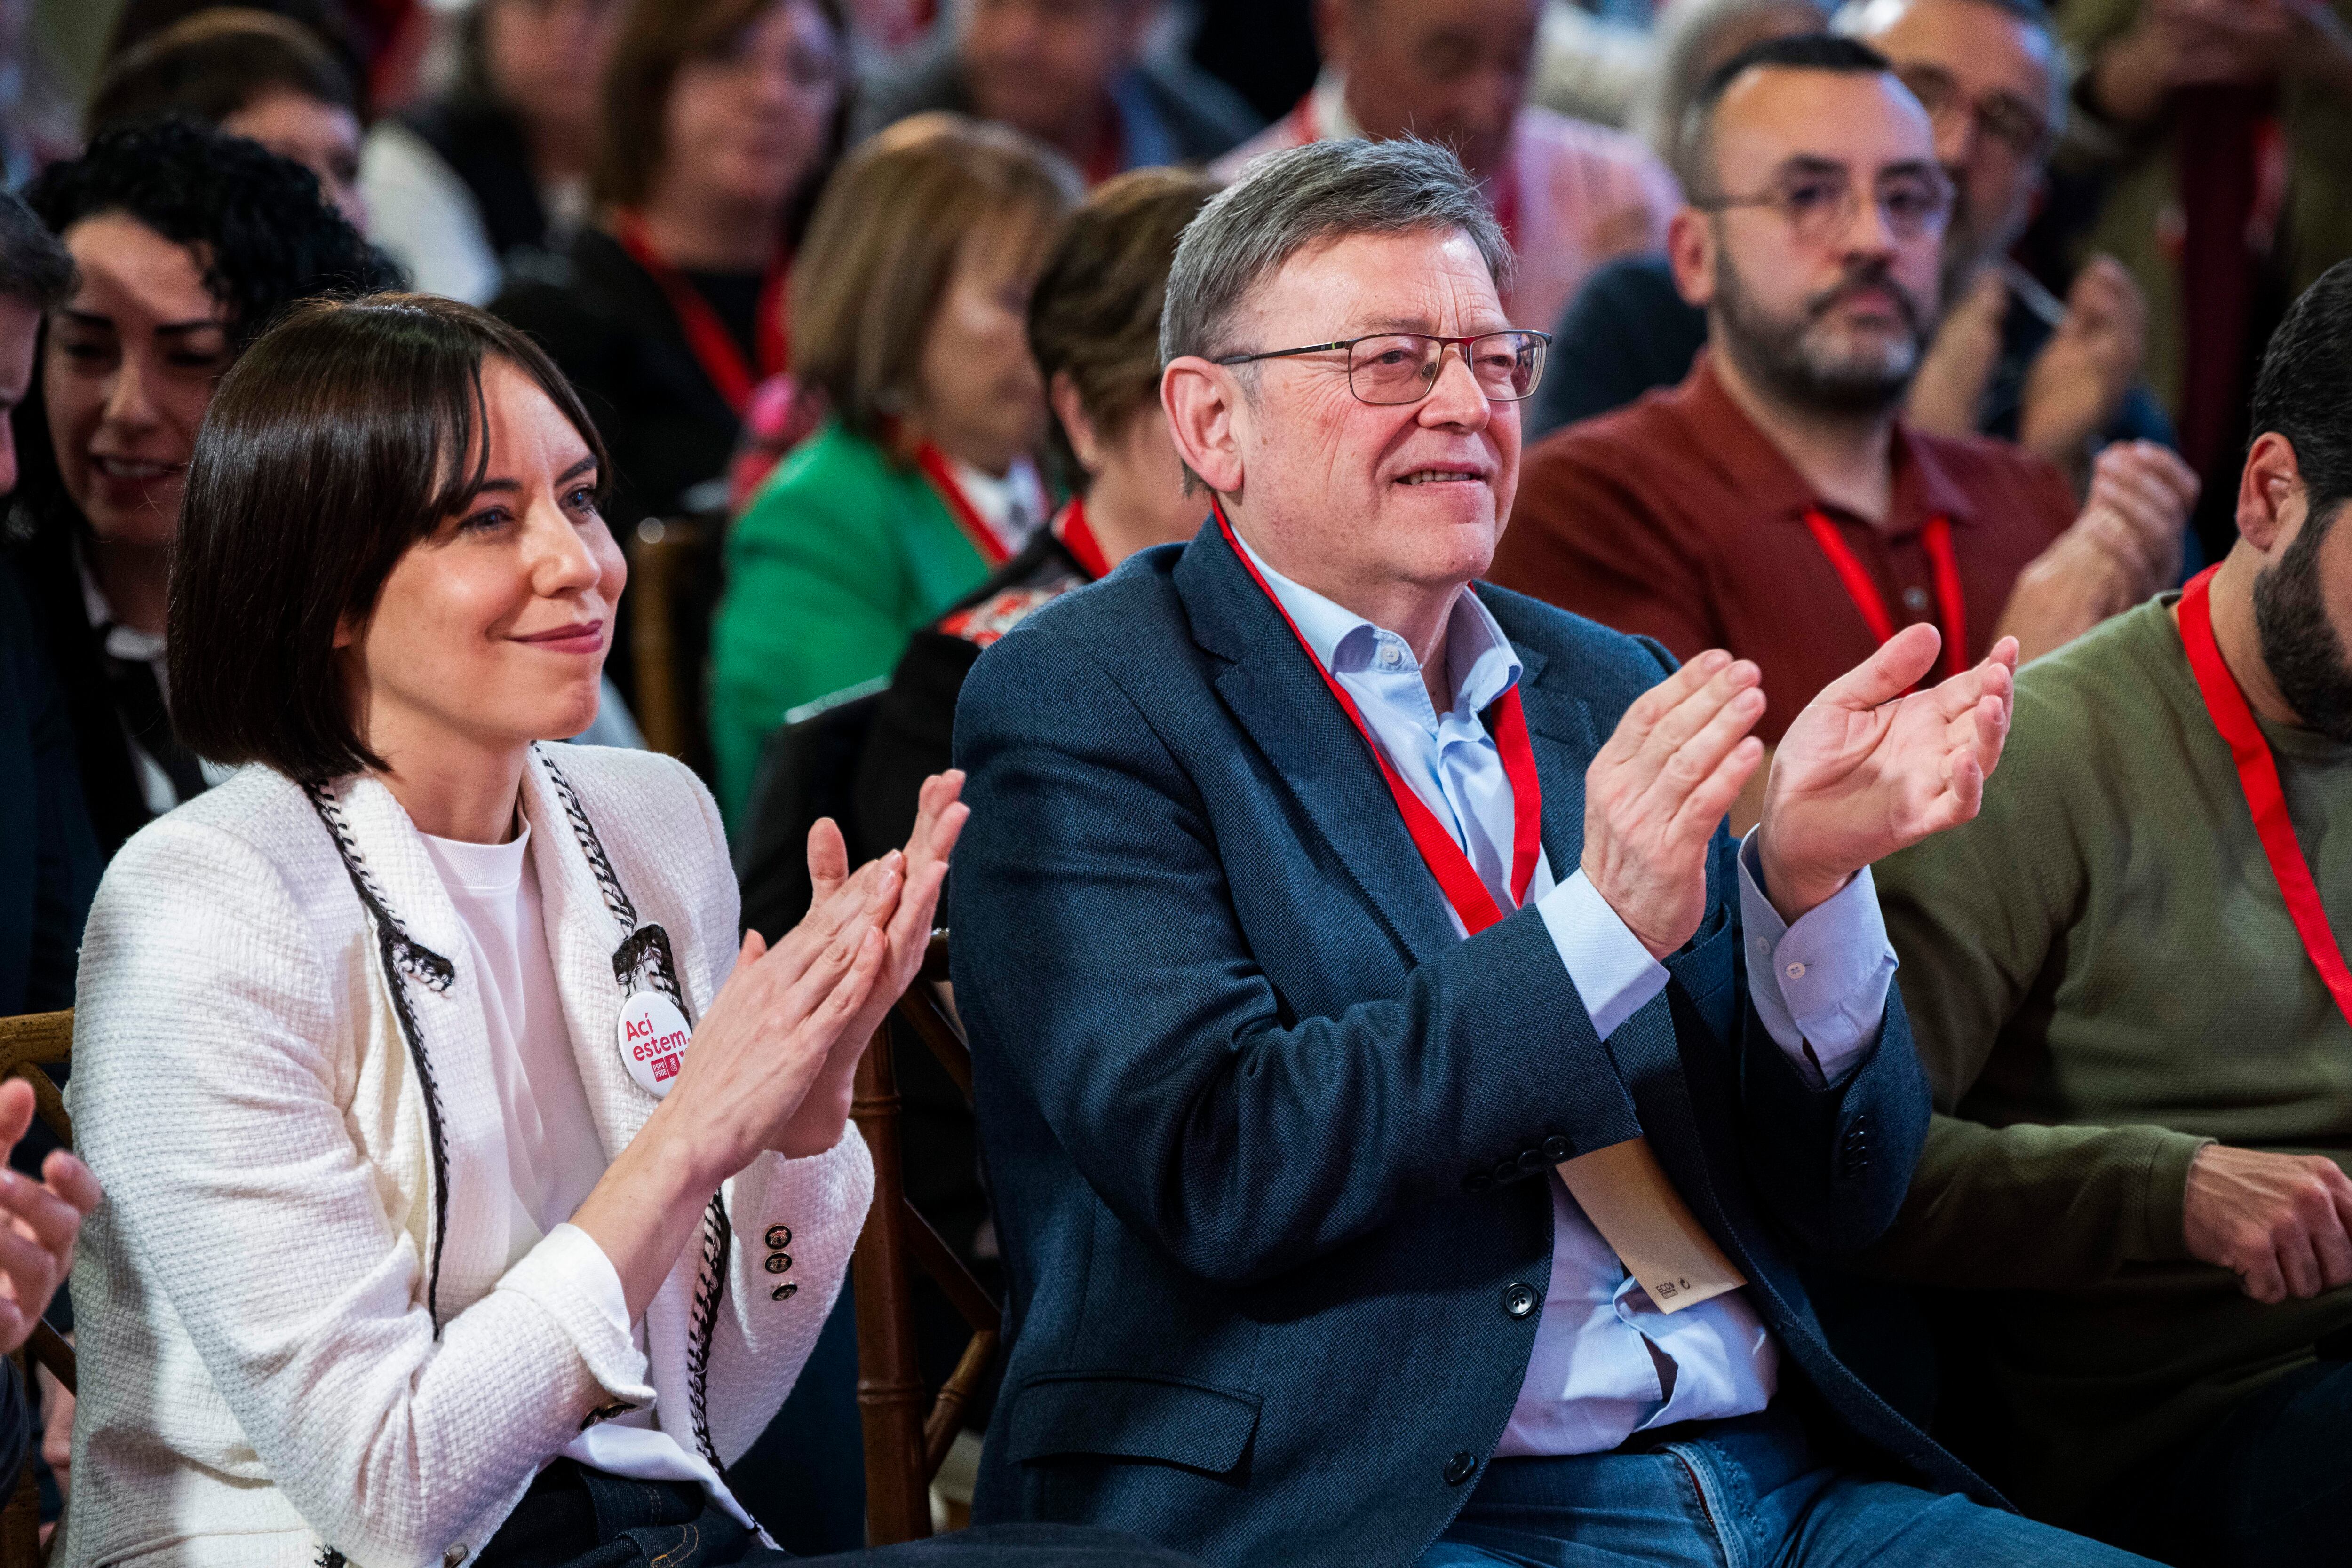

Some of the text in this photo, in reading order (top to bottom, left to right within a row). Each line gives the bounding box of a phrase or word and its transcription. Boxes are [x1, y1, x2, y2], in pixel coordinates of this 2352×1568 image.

[626, 1012, 654, 1041] Ací
[653, 1061, 665, 1071] PSPV
[655, 1069, 667, 1078] PSOE
